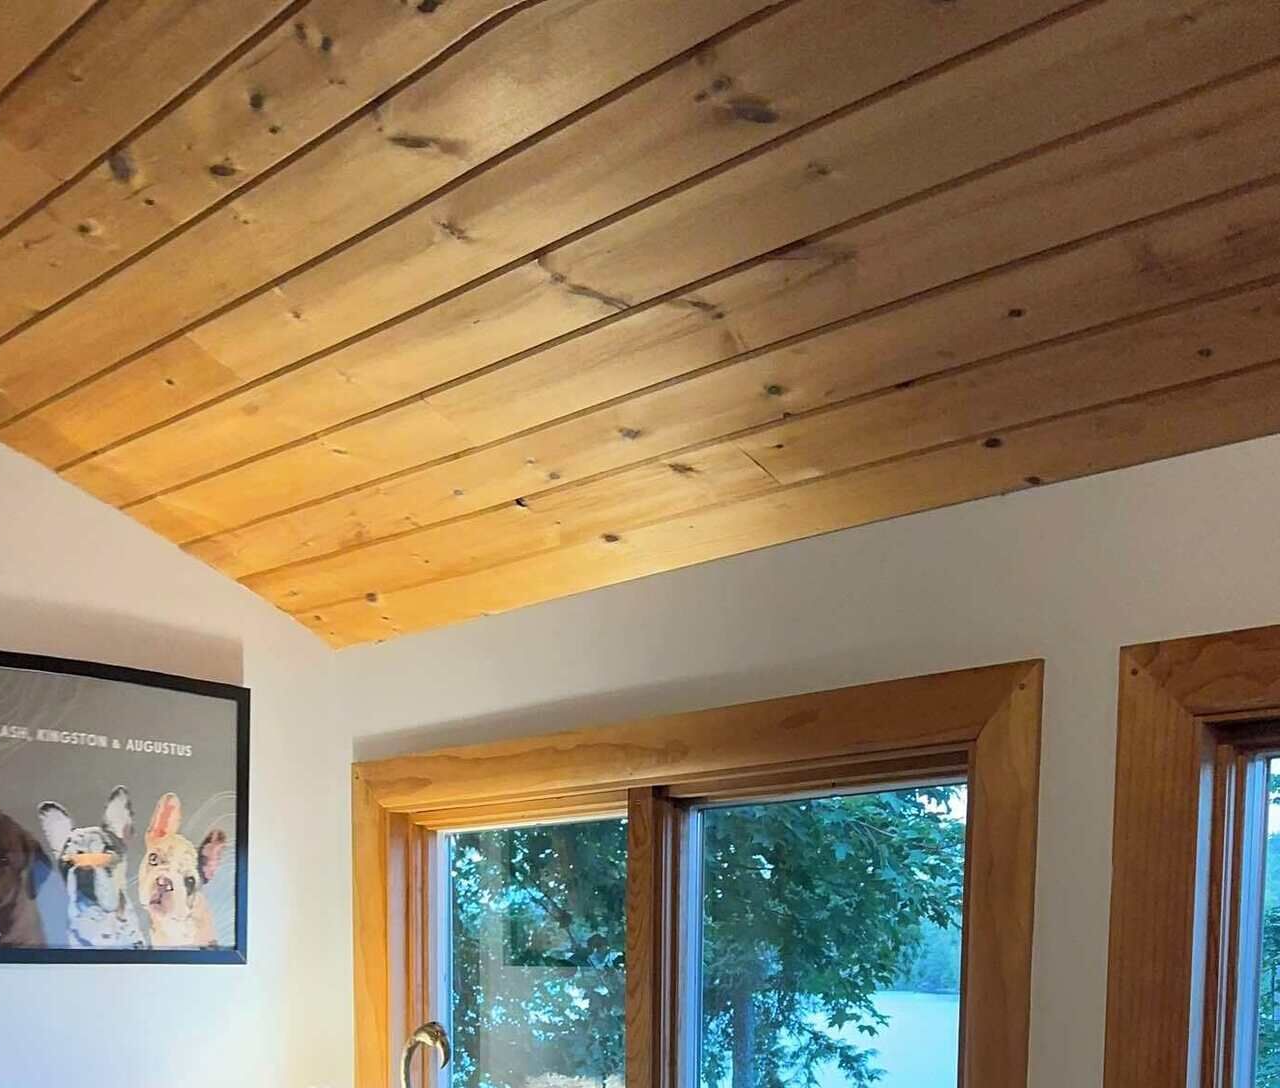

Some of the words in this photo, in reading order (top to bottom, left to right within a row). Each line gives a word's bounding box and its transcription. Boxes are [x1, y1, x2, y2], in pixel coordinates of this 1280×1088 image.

[37, 728, 108, 748] KINGSTON
[112, 738, 121, 749] &
[126, 739, 192, 757] AUGUSTUS
